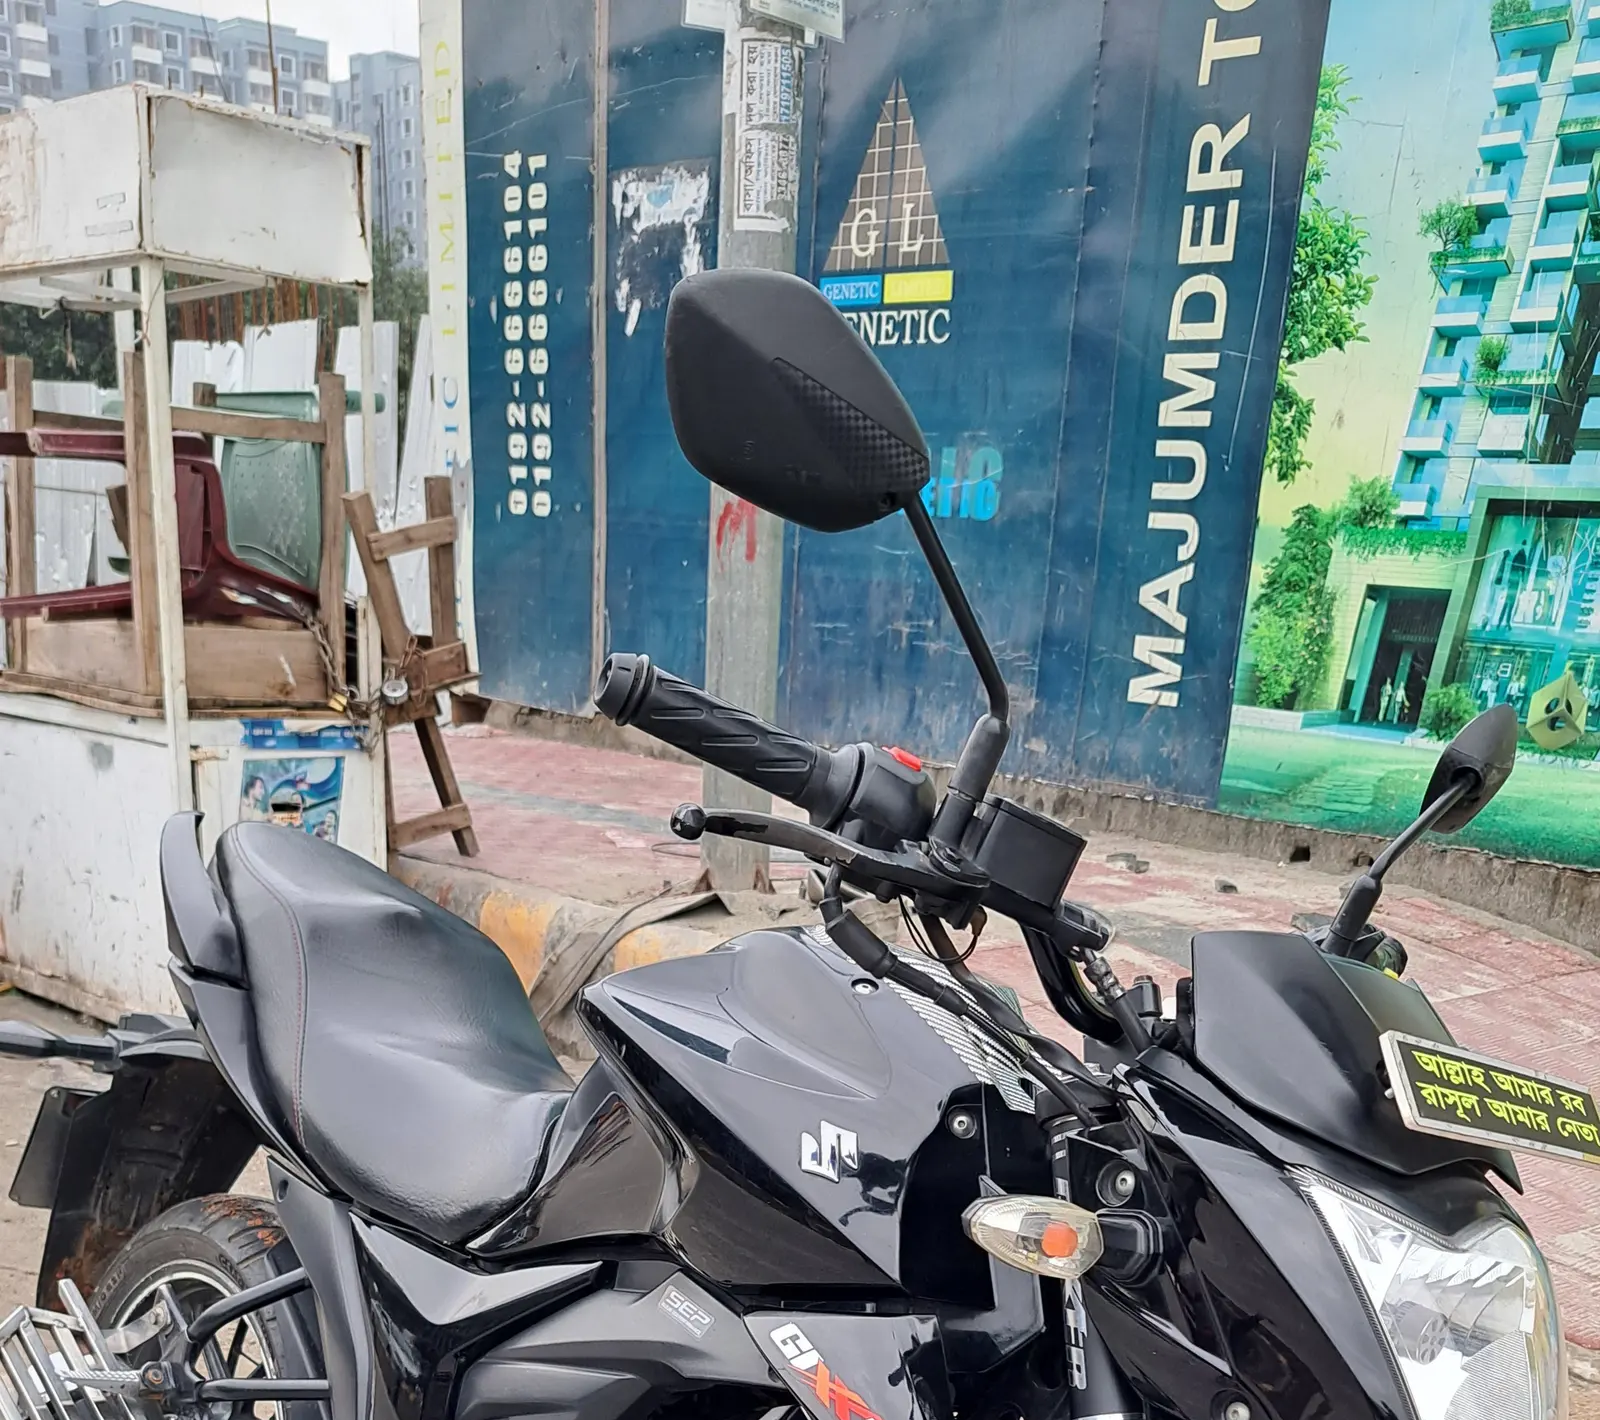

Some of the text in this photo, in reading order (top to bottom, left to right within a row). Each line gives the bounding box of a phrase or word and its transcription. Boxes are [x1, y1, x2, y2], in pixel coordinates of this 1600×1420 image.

[434, 40, 456, 336] LIMITED
[850, 203, 924, 257] G L
[823, 281, 880, 300] GENETIC
[503, 150, 528, 516] 0192-6666104
[527, 153, 552, 518] 0192-6666101
[844, 308, 951, 346] NETIC
[1126, 0, 1262, 707] MAJUMDER T
[1411, 1050, 1587, 1117] আল্লাহ আমার রব
[1415, 1081, 1600, 1147] রাসূল আমার নেতা
[665, 1290, 711, 1325] SEP
